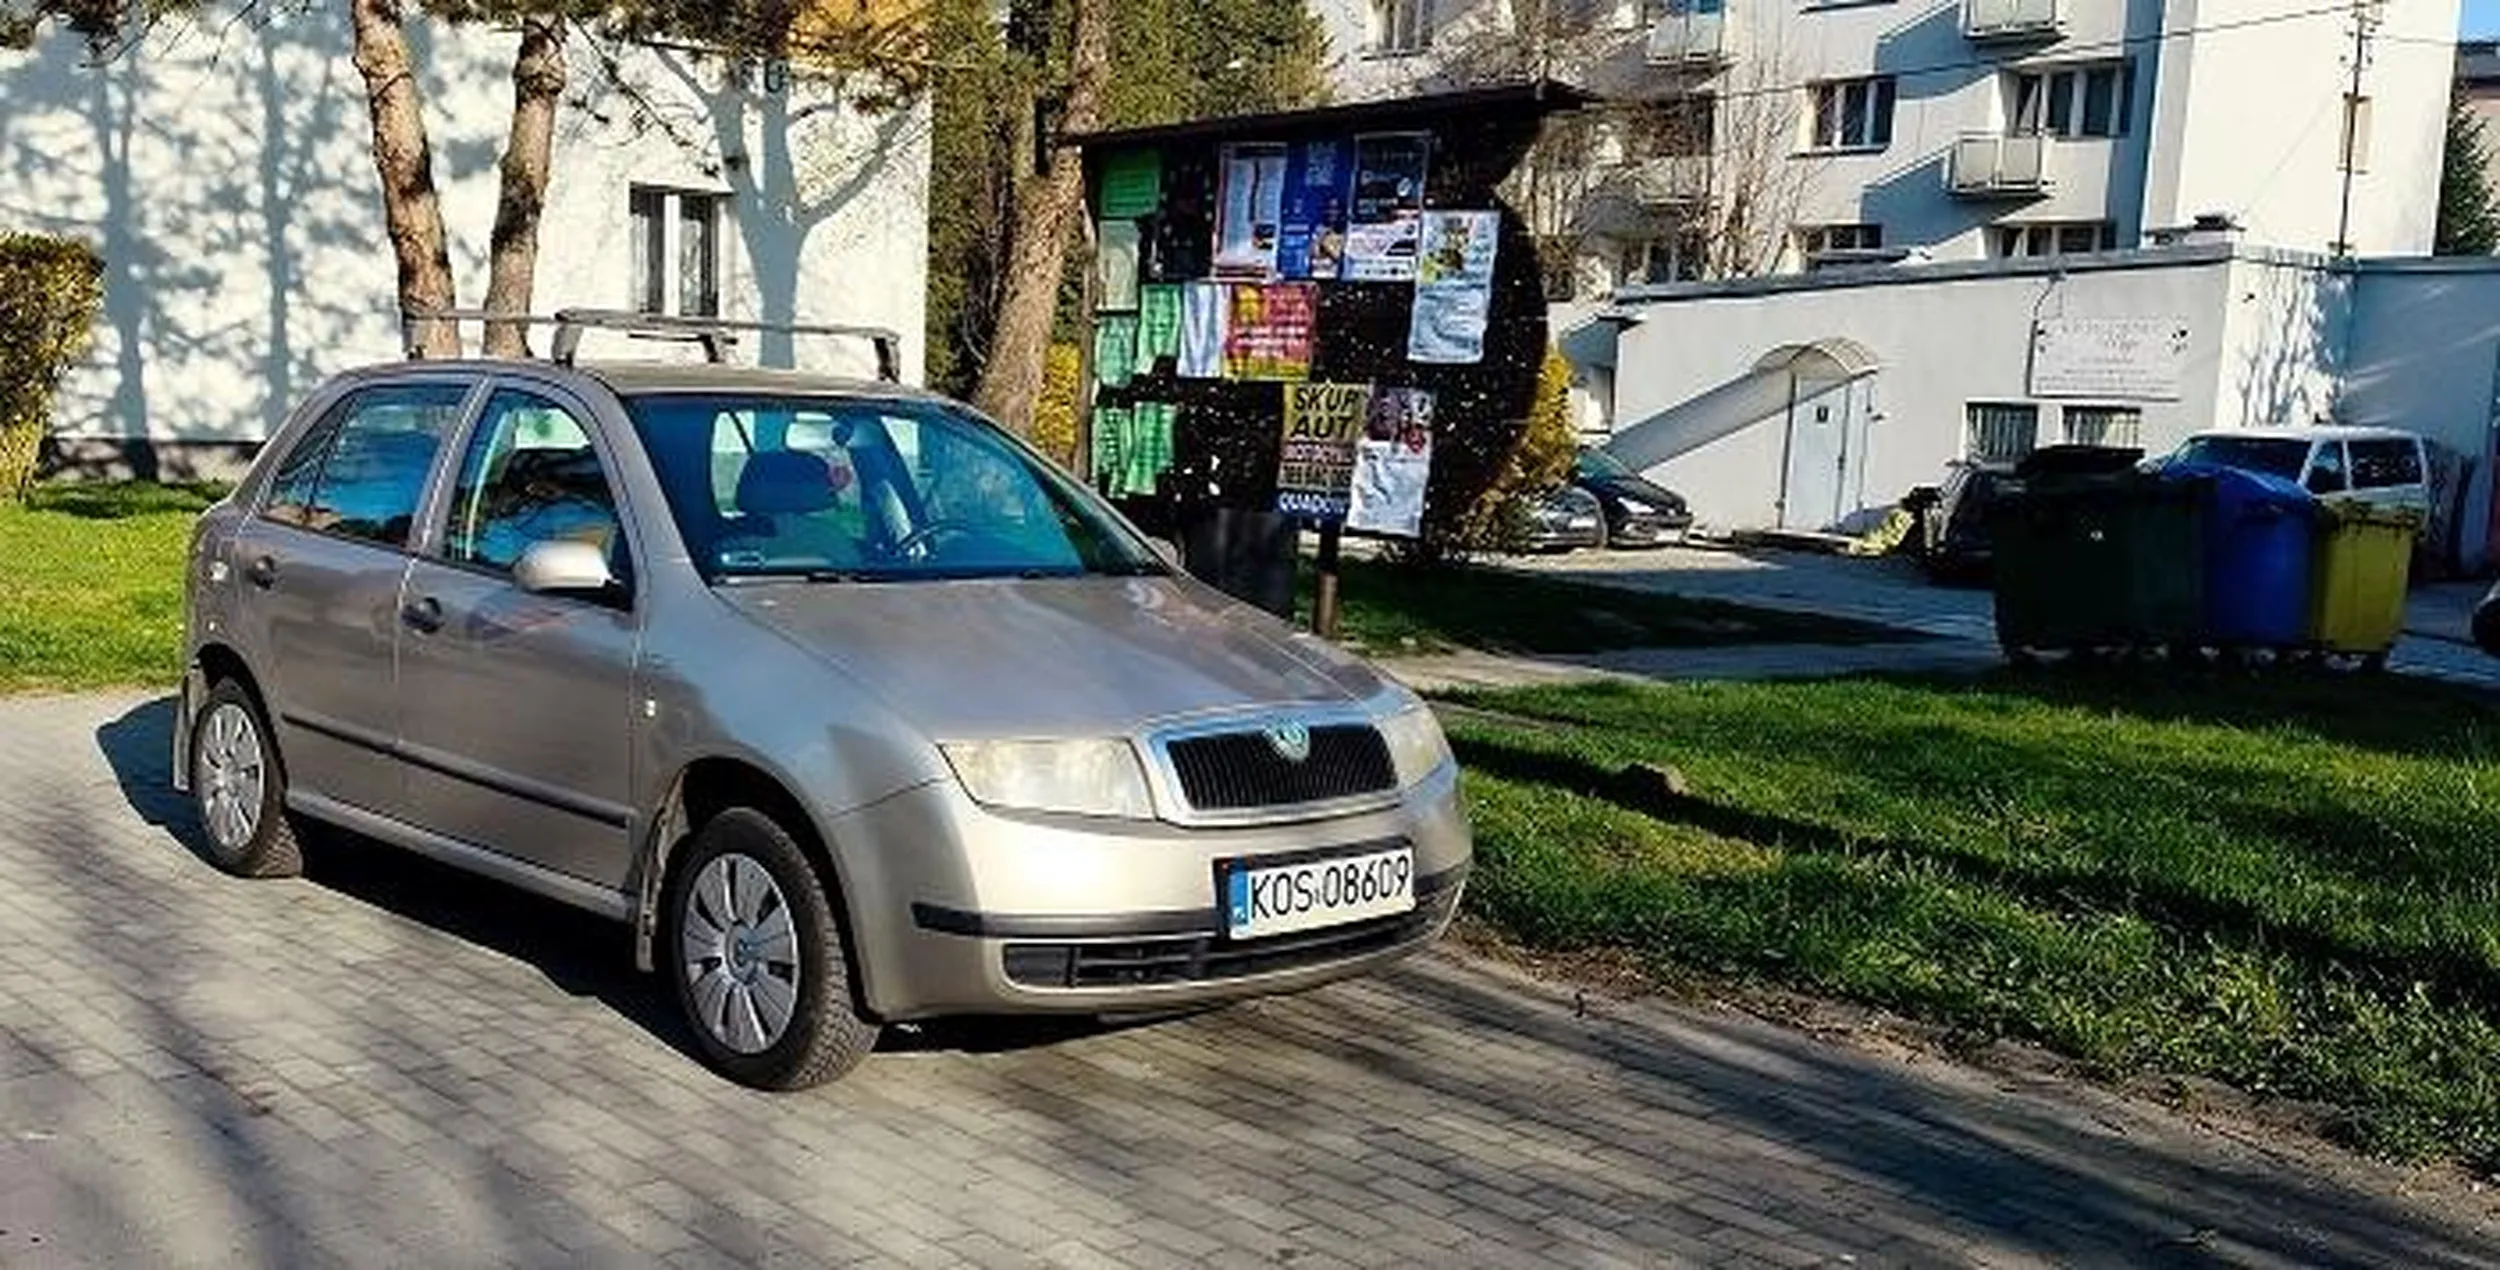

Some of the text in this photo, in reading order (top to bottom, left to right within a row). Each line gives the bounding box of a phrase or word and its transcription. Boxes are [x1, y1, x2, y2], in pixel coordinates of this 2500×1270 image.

[1294, 386, 1359, 412] SKUP
[1289, 414, 1355, 438] AUT
[1251, 855, 1408, 919] KOS 08609
